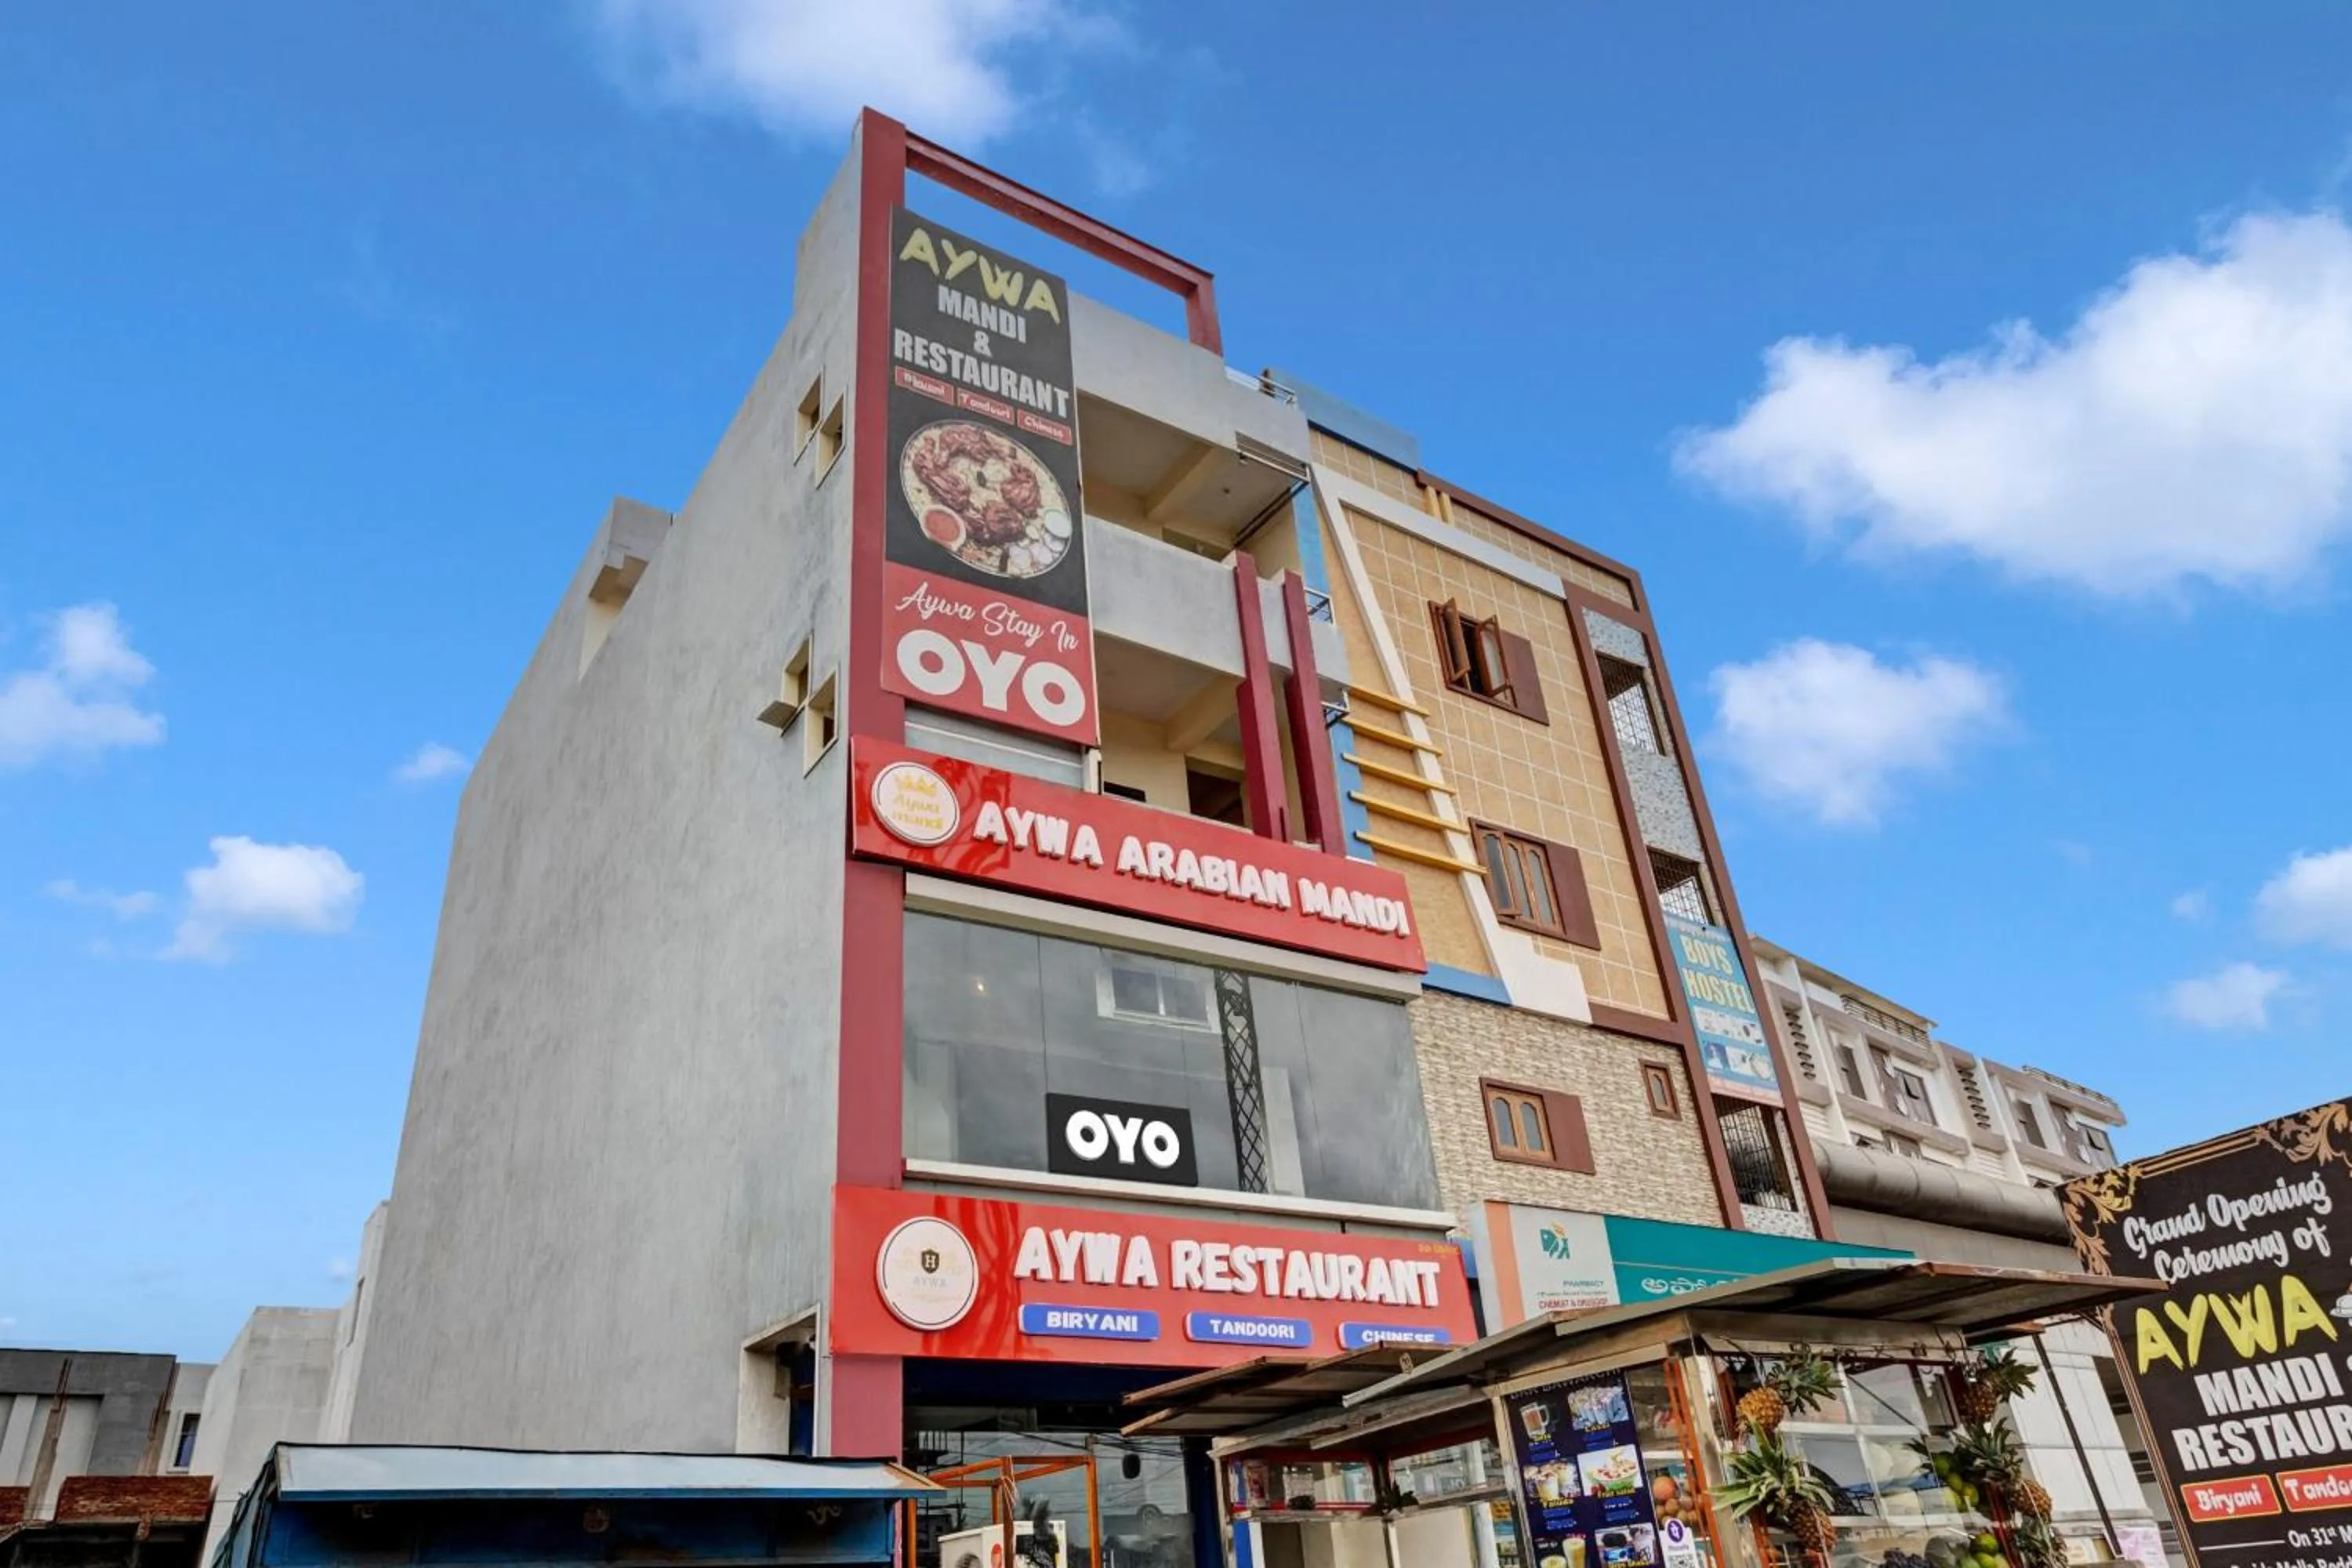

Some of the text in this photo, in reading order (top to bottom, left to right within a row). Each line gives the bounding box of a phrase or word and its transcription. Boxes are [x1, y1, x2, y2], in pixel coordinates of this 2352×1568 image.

[899, 228, 1060, 325] AYWA
[938, 285, 1027, 344] MANDI
[973, 330, 993, 358] &
[893, 328, 1069, 419] RESTAURANT
[895, 582, 1080, 653] Aywa Stay In
[896, 629, 1087, 727] OYO
[973, 800, 1410, 938] AYWA ARABIAN MANDI
[1679, 934, 1734, 978] BOYS
[1682, 967, 1757, 1014] HOSTEL
[1065, 1109, 1181, 1170] OYO
[2123, 1171, 2333, 1260] Grand Opening
[1014, 1225, 1440, 1308] AYWA RESTAURANT
[2154, 1218, 2332, 1285] Ceremony of
[1047, 1311, 1436, 1342] BIRYANI TANDOORI CHINESE
[2136, 1274, 2339, 1375] AYWA
[2194, 1352, 2345, 1417] MANDI
[2193, 1483, 2263, 1514] Biryani
[2287, 1530, 2312, 1548] On
